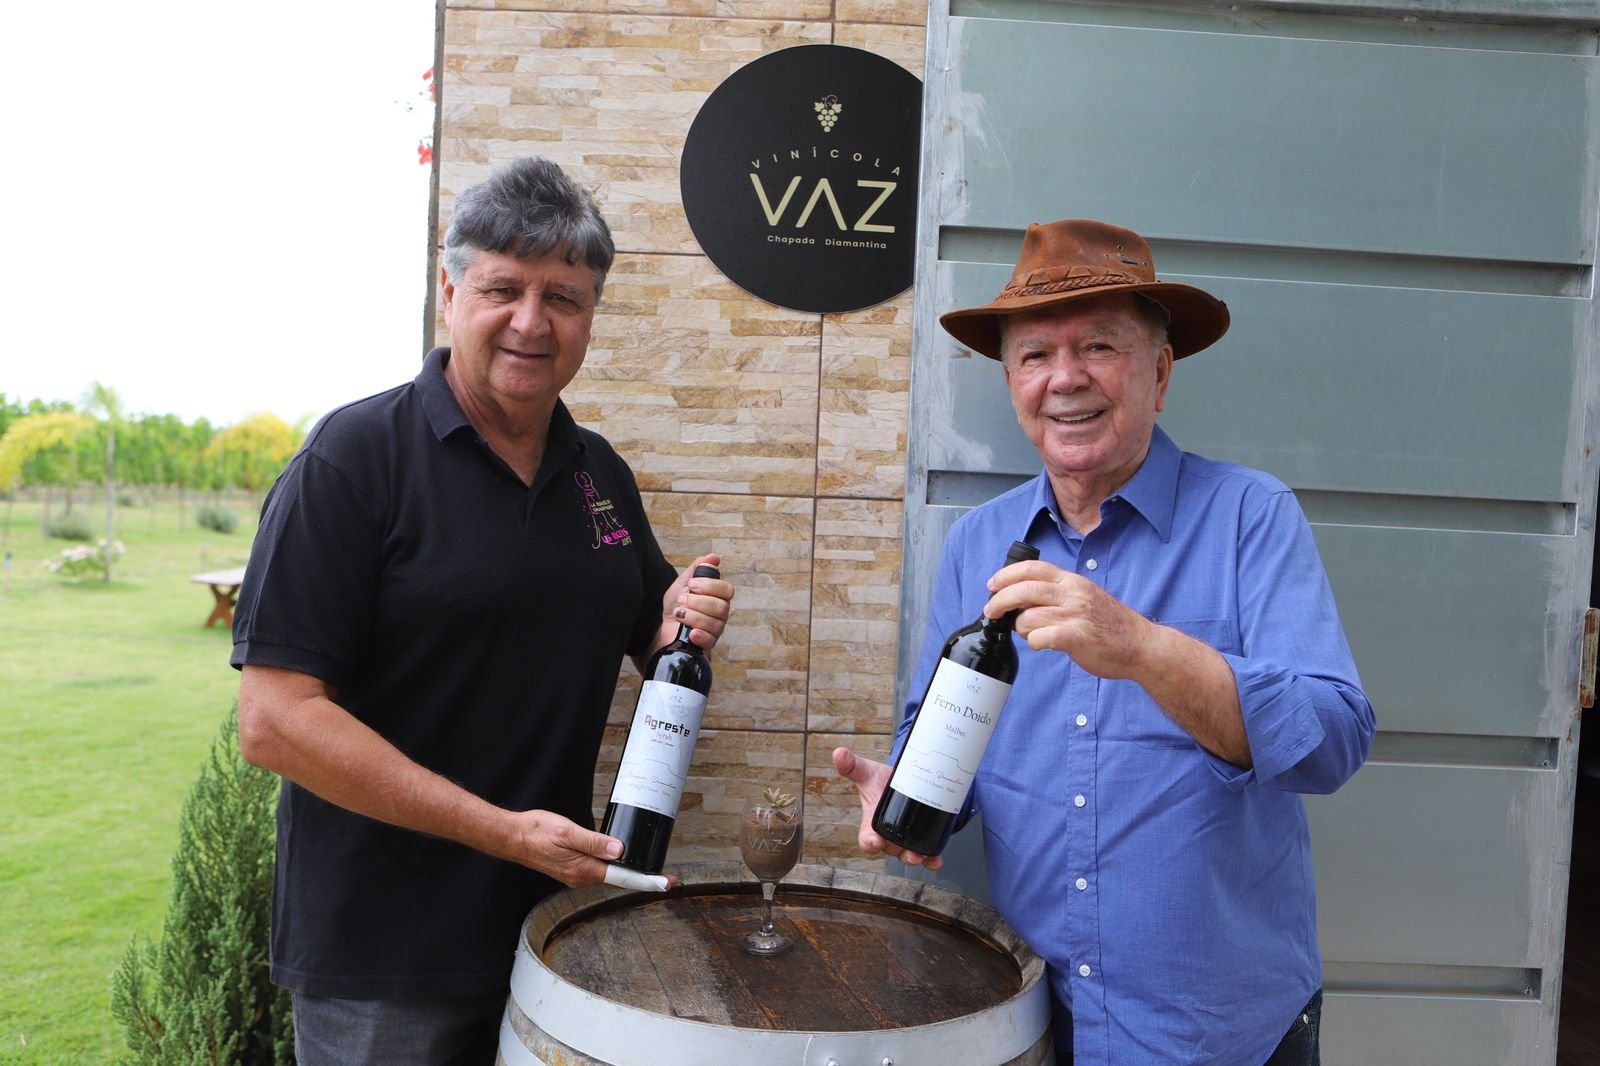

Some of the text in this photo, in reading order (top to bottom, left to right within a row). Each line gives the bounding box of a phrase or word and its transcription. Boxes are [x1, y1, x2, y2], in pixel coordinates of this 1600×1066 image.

[751, 146, 900, 176] VINÍCOLA
[750, 173, 897, 233] VAZ
[767, 235, 887, 249] Chapada Diamantina
[966, 682, 982, 694] VAZ
[934, 694, 992, 726] Ferro Doido
[644, 714, 690, 738] Agreste
[944, 723, 967, 738] Malbec
